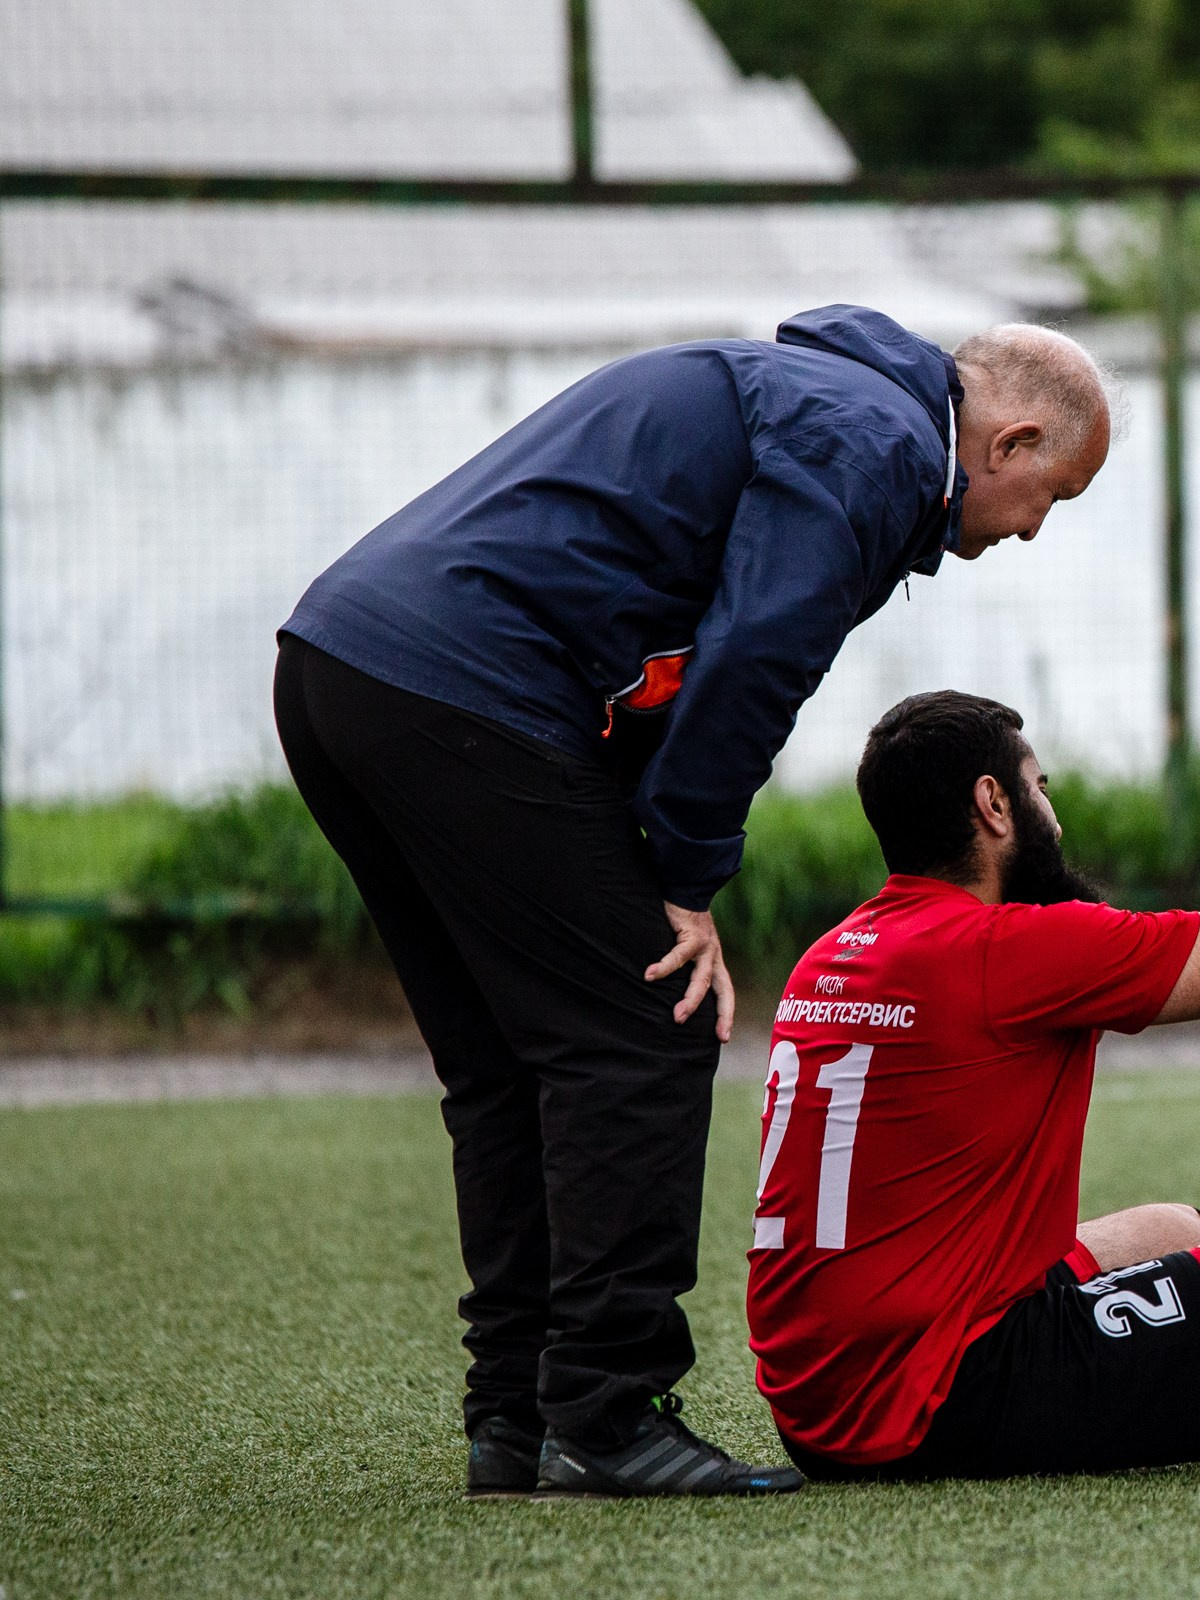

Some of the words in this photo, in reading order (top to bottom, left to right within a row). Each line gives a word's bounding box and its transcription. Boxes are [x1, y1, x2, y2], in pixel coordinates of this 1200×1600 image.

[836, 931, 880, 947] ПРОФИ
[814, 974, 849, 996] МФК
[752, 1040, 875, 1250] 21
[1078, 1259, 1187, 1338] 21
